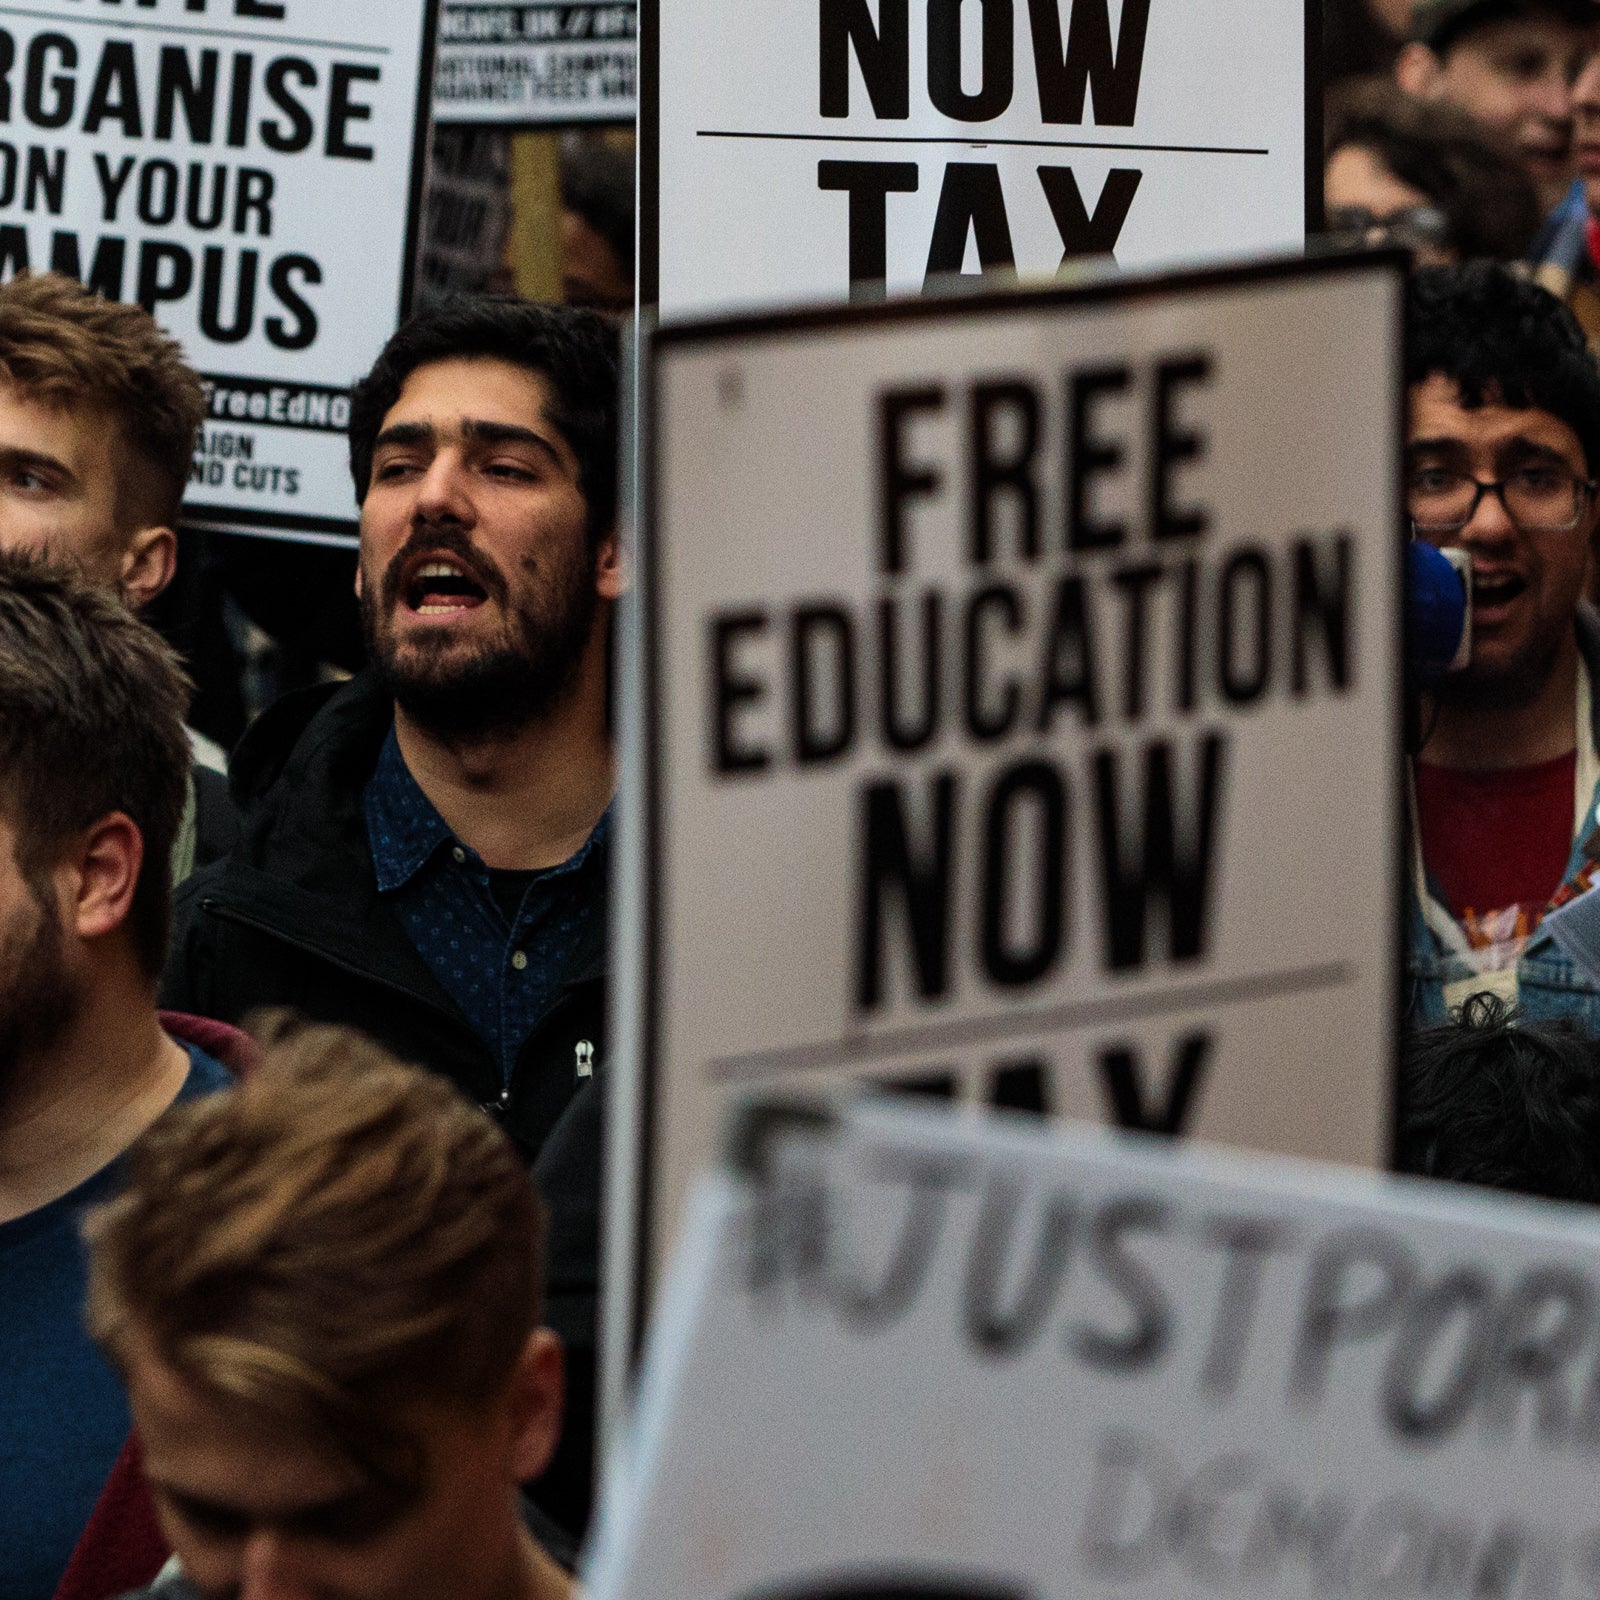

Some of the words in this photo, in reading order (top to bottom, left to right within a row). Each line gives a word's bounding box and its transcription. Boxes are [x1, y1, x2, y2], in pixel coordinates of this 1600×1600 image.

[94, 153, 276, 237] YOUR
[817, 159, 1143, 302] TAX
[233, 463, 299, 495] CUTS
[871, 348, 1218, 573] FREE
[704, 526, 1357, 781] EDUCATION
[846, 729, 1231, 1022] NOW
